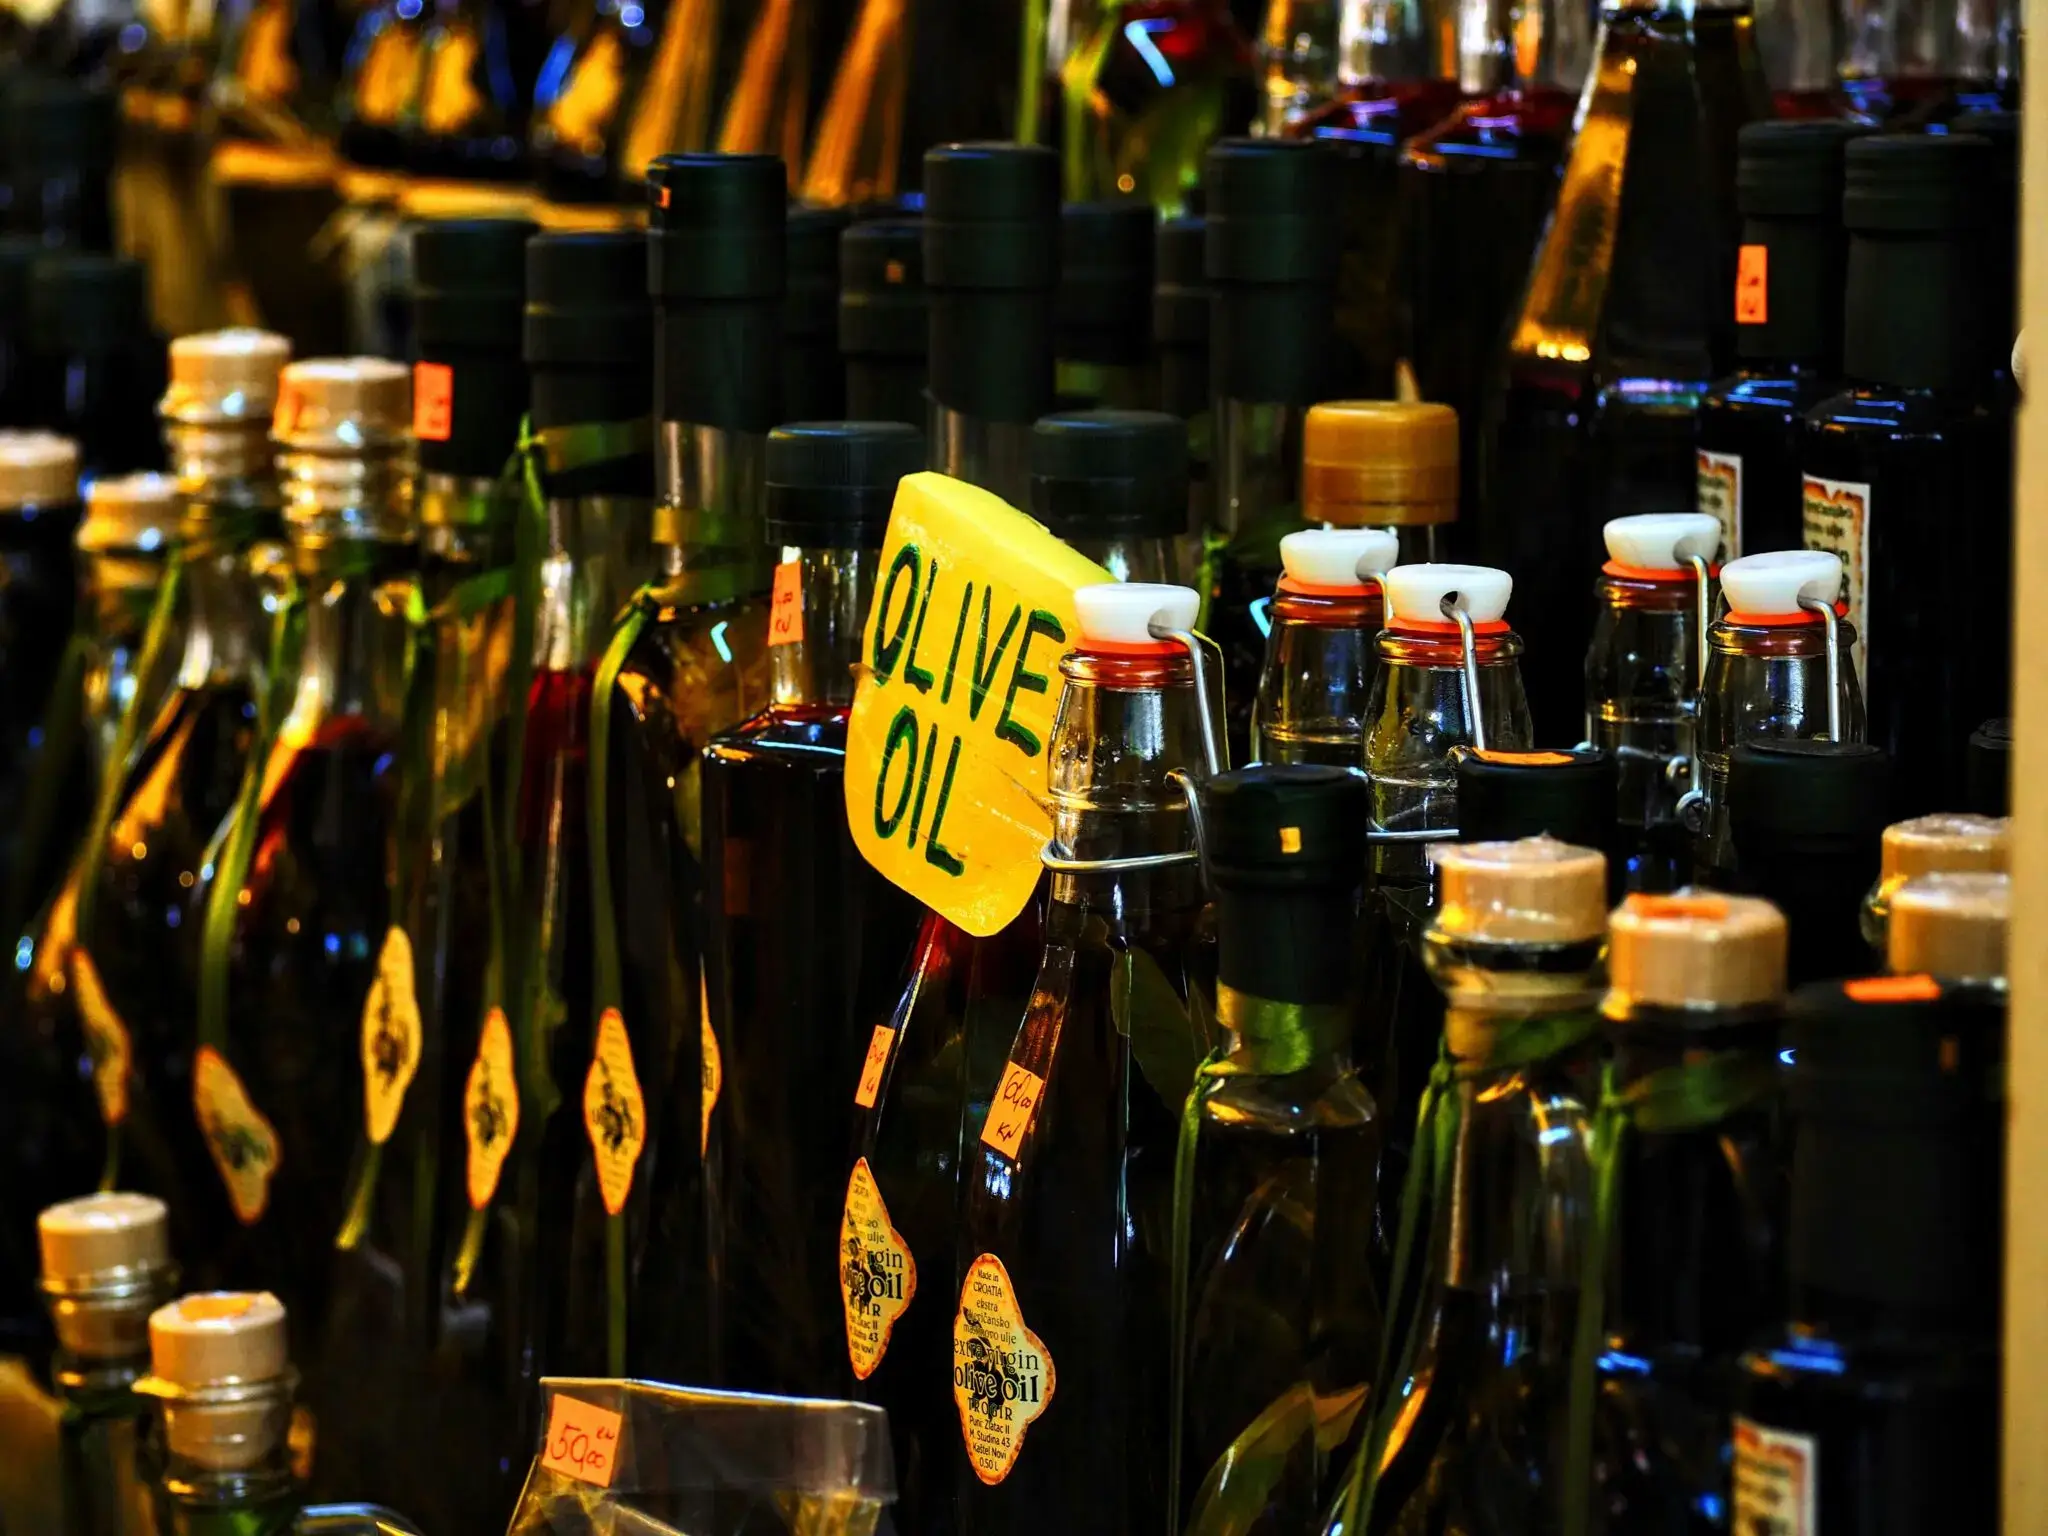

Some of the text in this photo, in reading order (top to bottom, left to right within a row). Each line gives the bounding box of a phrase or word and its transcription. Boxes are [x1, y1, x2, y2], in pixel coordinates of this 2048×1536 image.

[873, 543, 1066, 757] OLIVE
[874, 705, 964, 876] OIL
[867, 1231, 885, 1244] ulje
[977, 1268, 999, 1282] Made in
[868, 1272, 903, 1300] oil
[973, 1281, 1003, 1298] CROATIA
[976, 1298, 998, 1312] ekstra
[1000, 1331, 1017, 1345] ulje
[954, 1337, 1039, 1374] extra virgin
[954, 1361, 1039, 1403] olive oil
[967, 1396, 1013, 1421] TROGIR
[1001, 1437, 1011, 1448] 43
